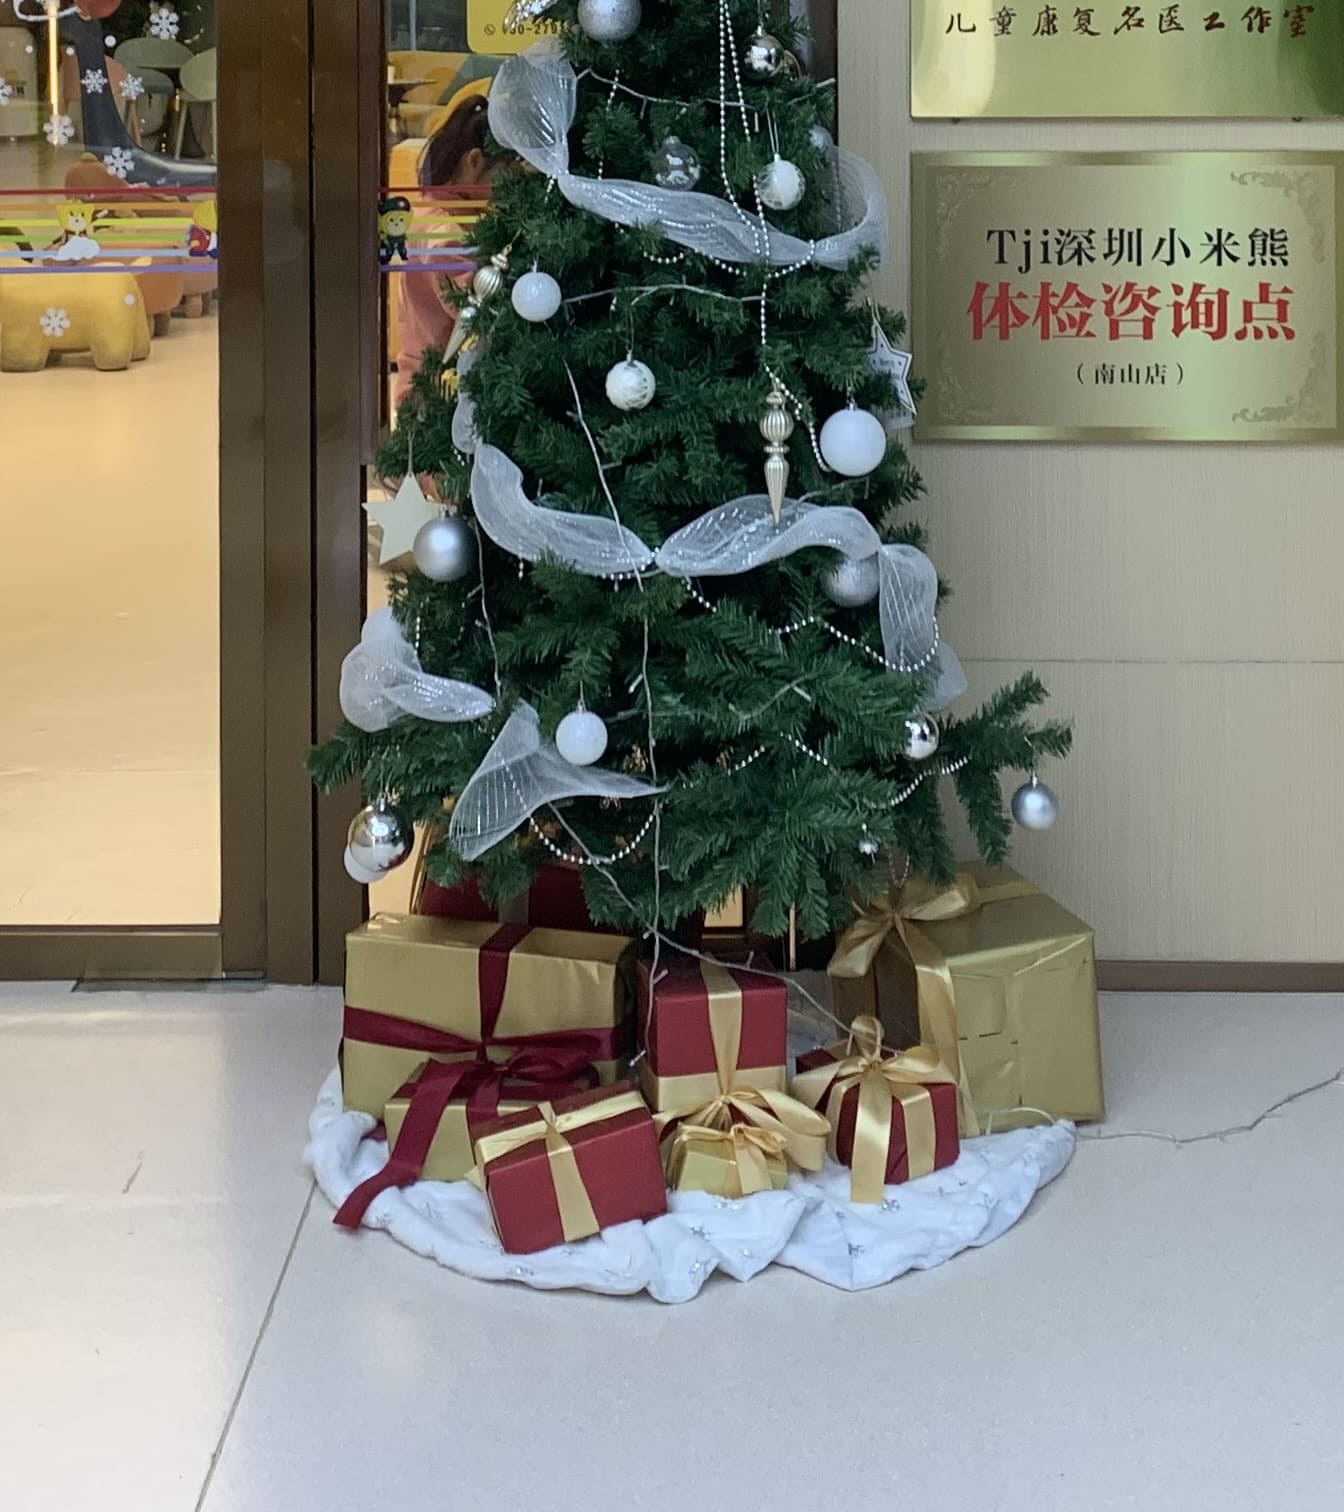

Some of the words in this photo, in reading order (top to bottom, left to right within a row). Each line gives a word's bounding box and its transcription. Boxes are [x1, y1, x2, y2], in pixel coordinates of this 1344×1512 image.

[945, 4, 1315, 38] 儿童康复名医工作室
[986, 227, 1290, 275] Tji深圳小米熊
[966, 281, 1296, 341] 体检咨询点
